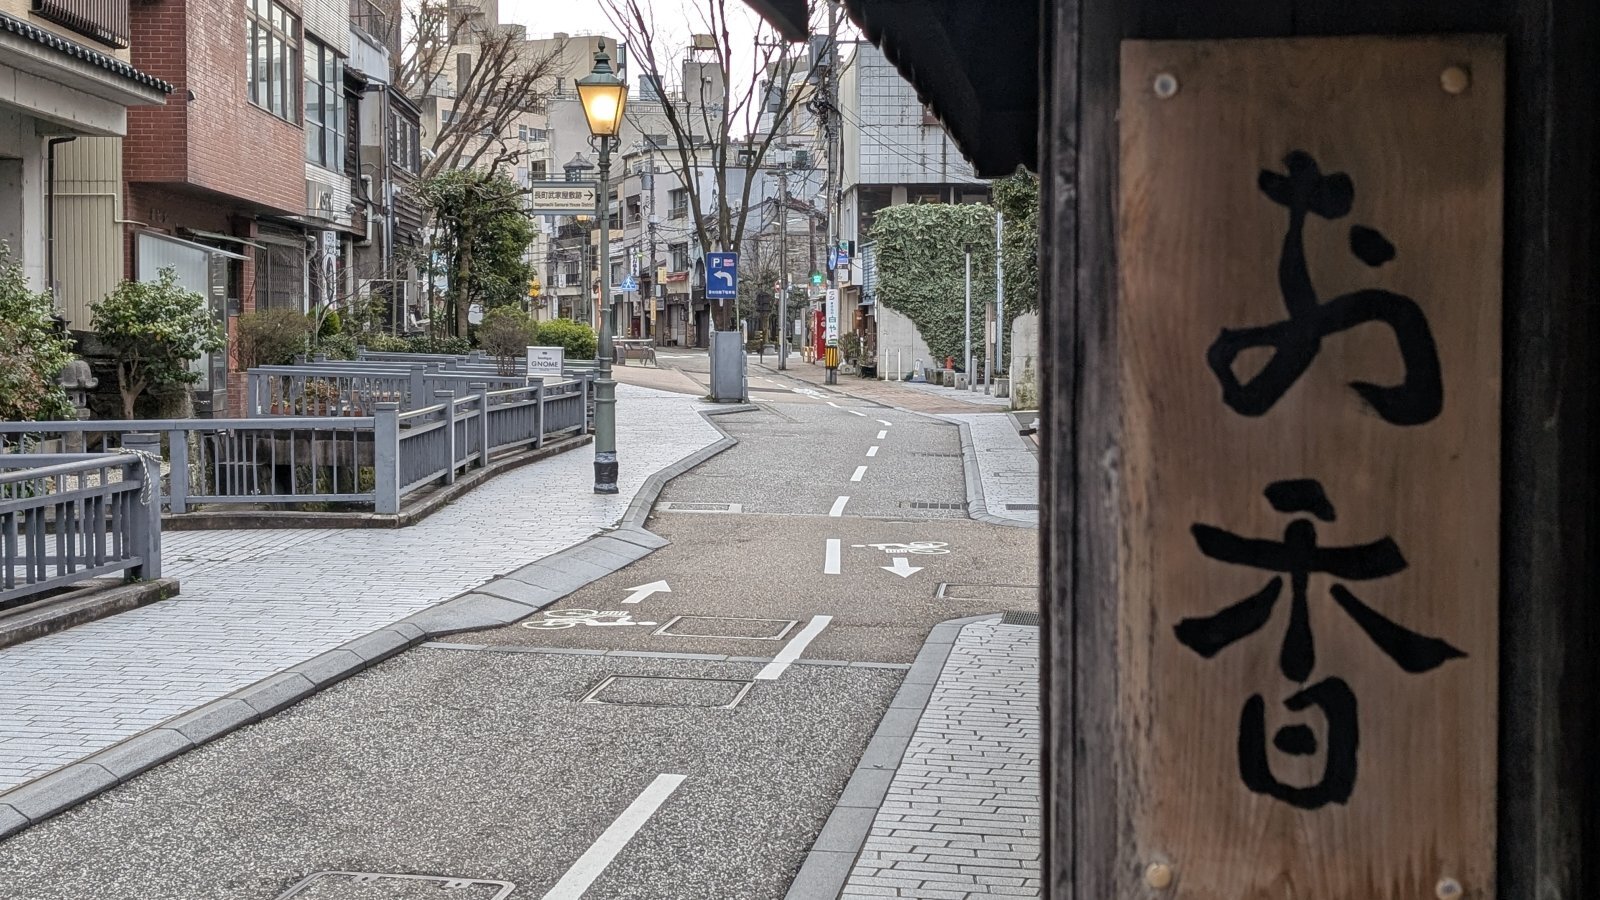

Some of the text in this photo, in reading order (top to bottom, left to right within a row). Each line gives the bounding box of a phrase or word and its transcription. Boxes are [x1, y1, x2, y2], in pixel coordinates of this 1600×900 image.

[535, 191, 582, 199] 長町武家屋敷跡
[713, 258, 720, 268] P
[1174, 150, 1468, 809] お香
